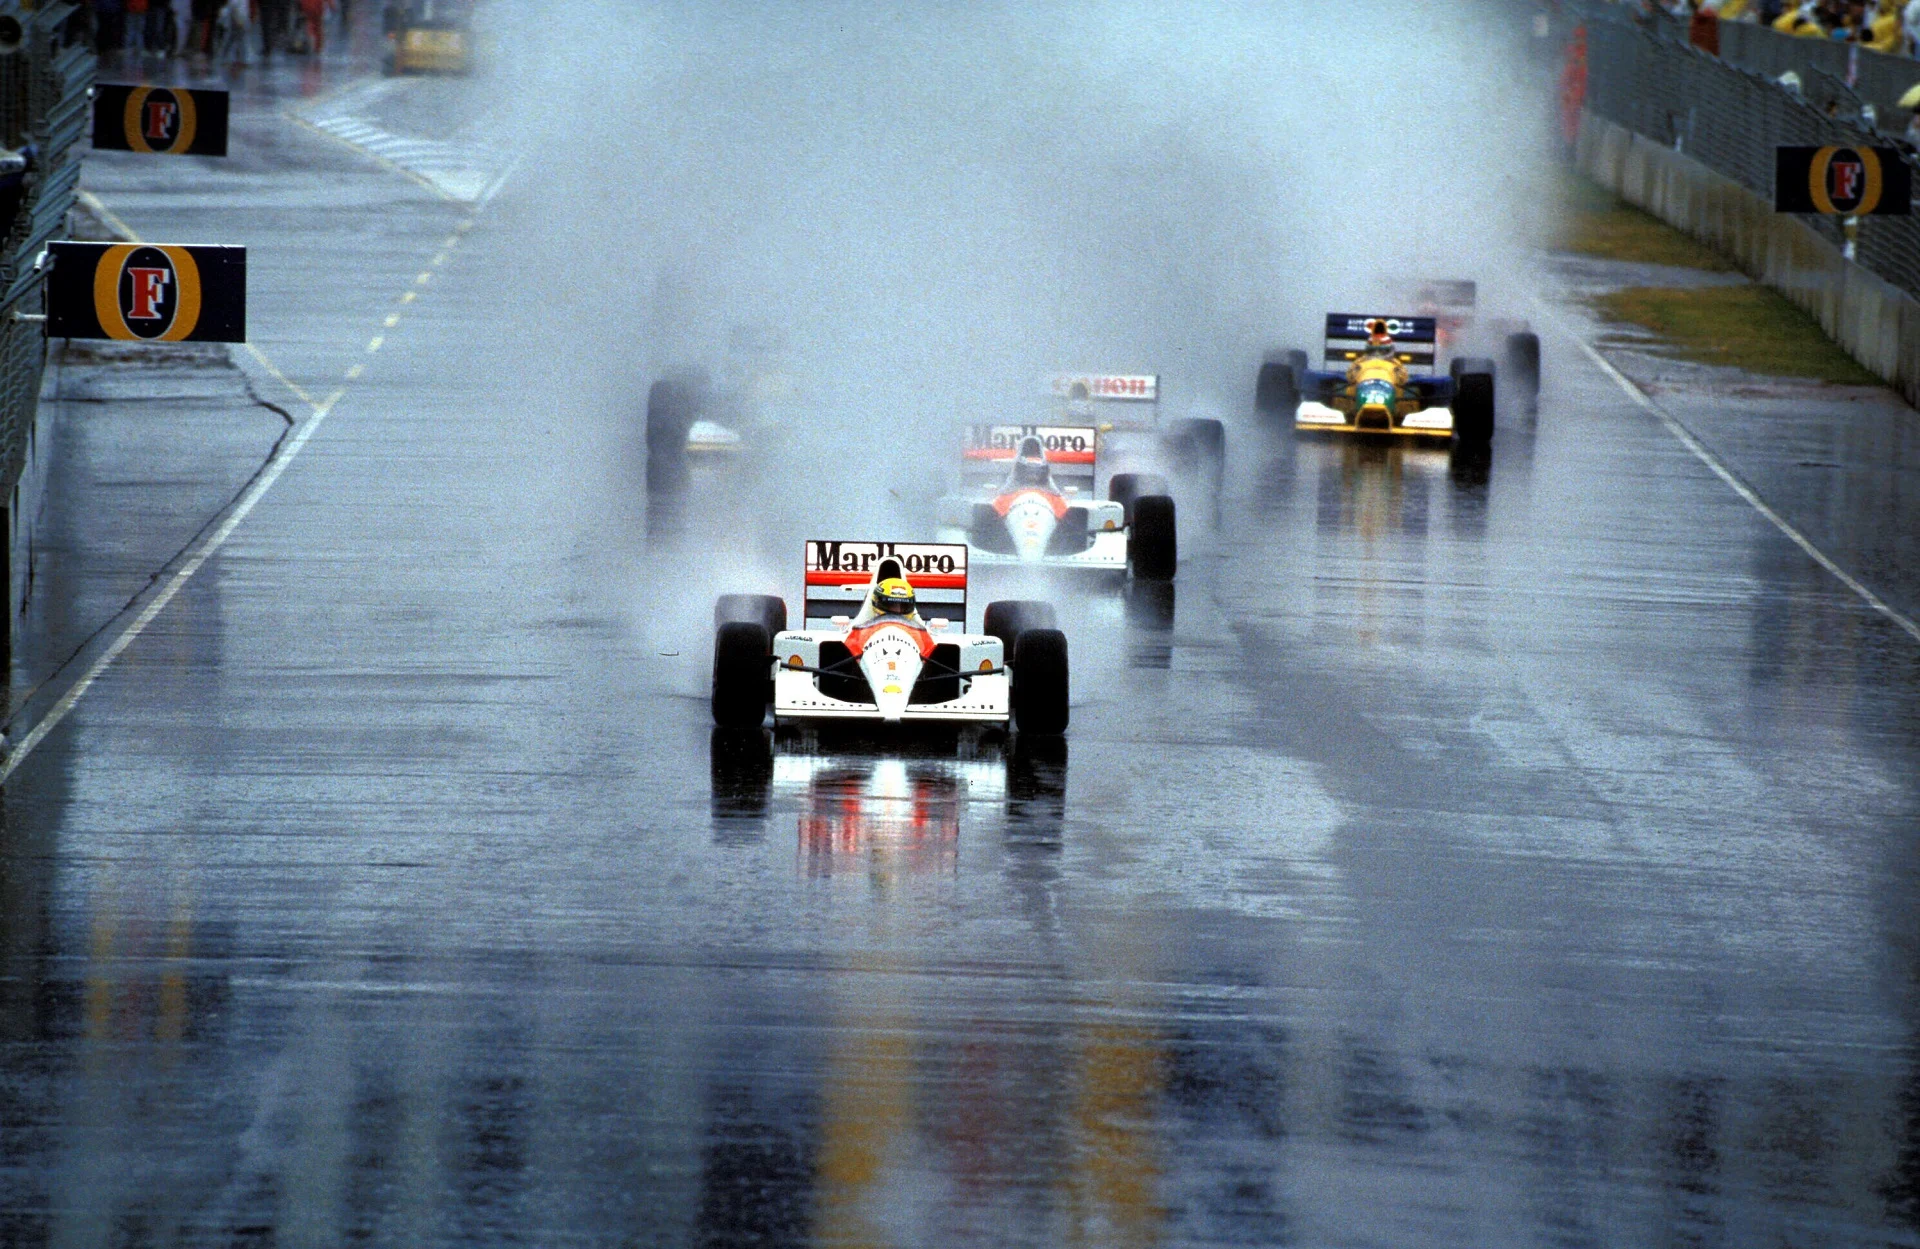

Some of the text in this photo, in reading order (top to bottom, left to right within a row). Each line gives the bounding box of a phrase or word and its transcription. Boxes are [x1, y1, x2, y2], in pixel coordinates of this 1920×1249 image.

[146, 101, 176, 139] F
[1831, 161, 1861, 200] F
[127, 267, 170, 319] F
